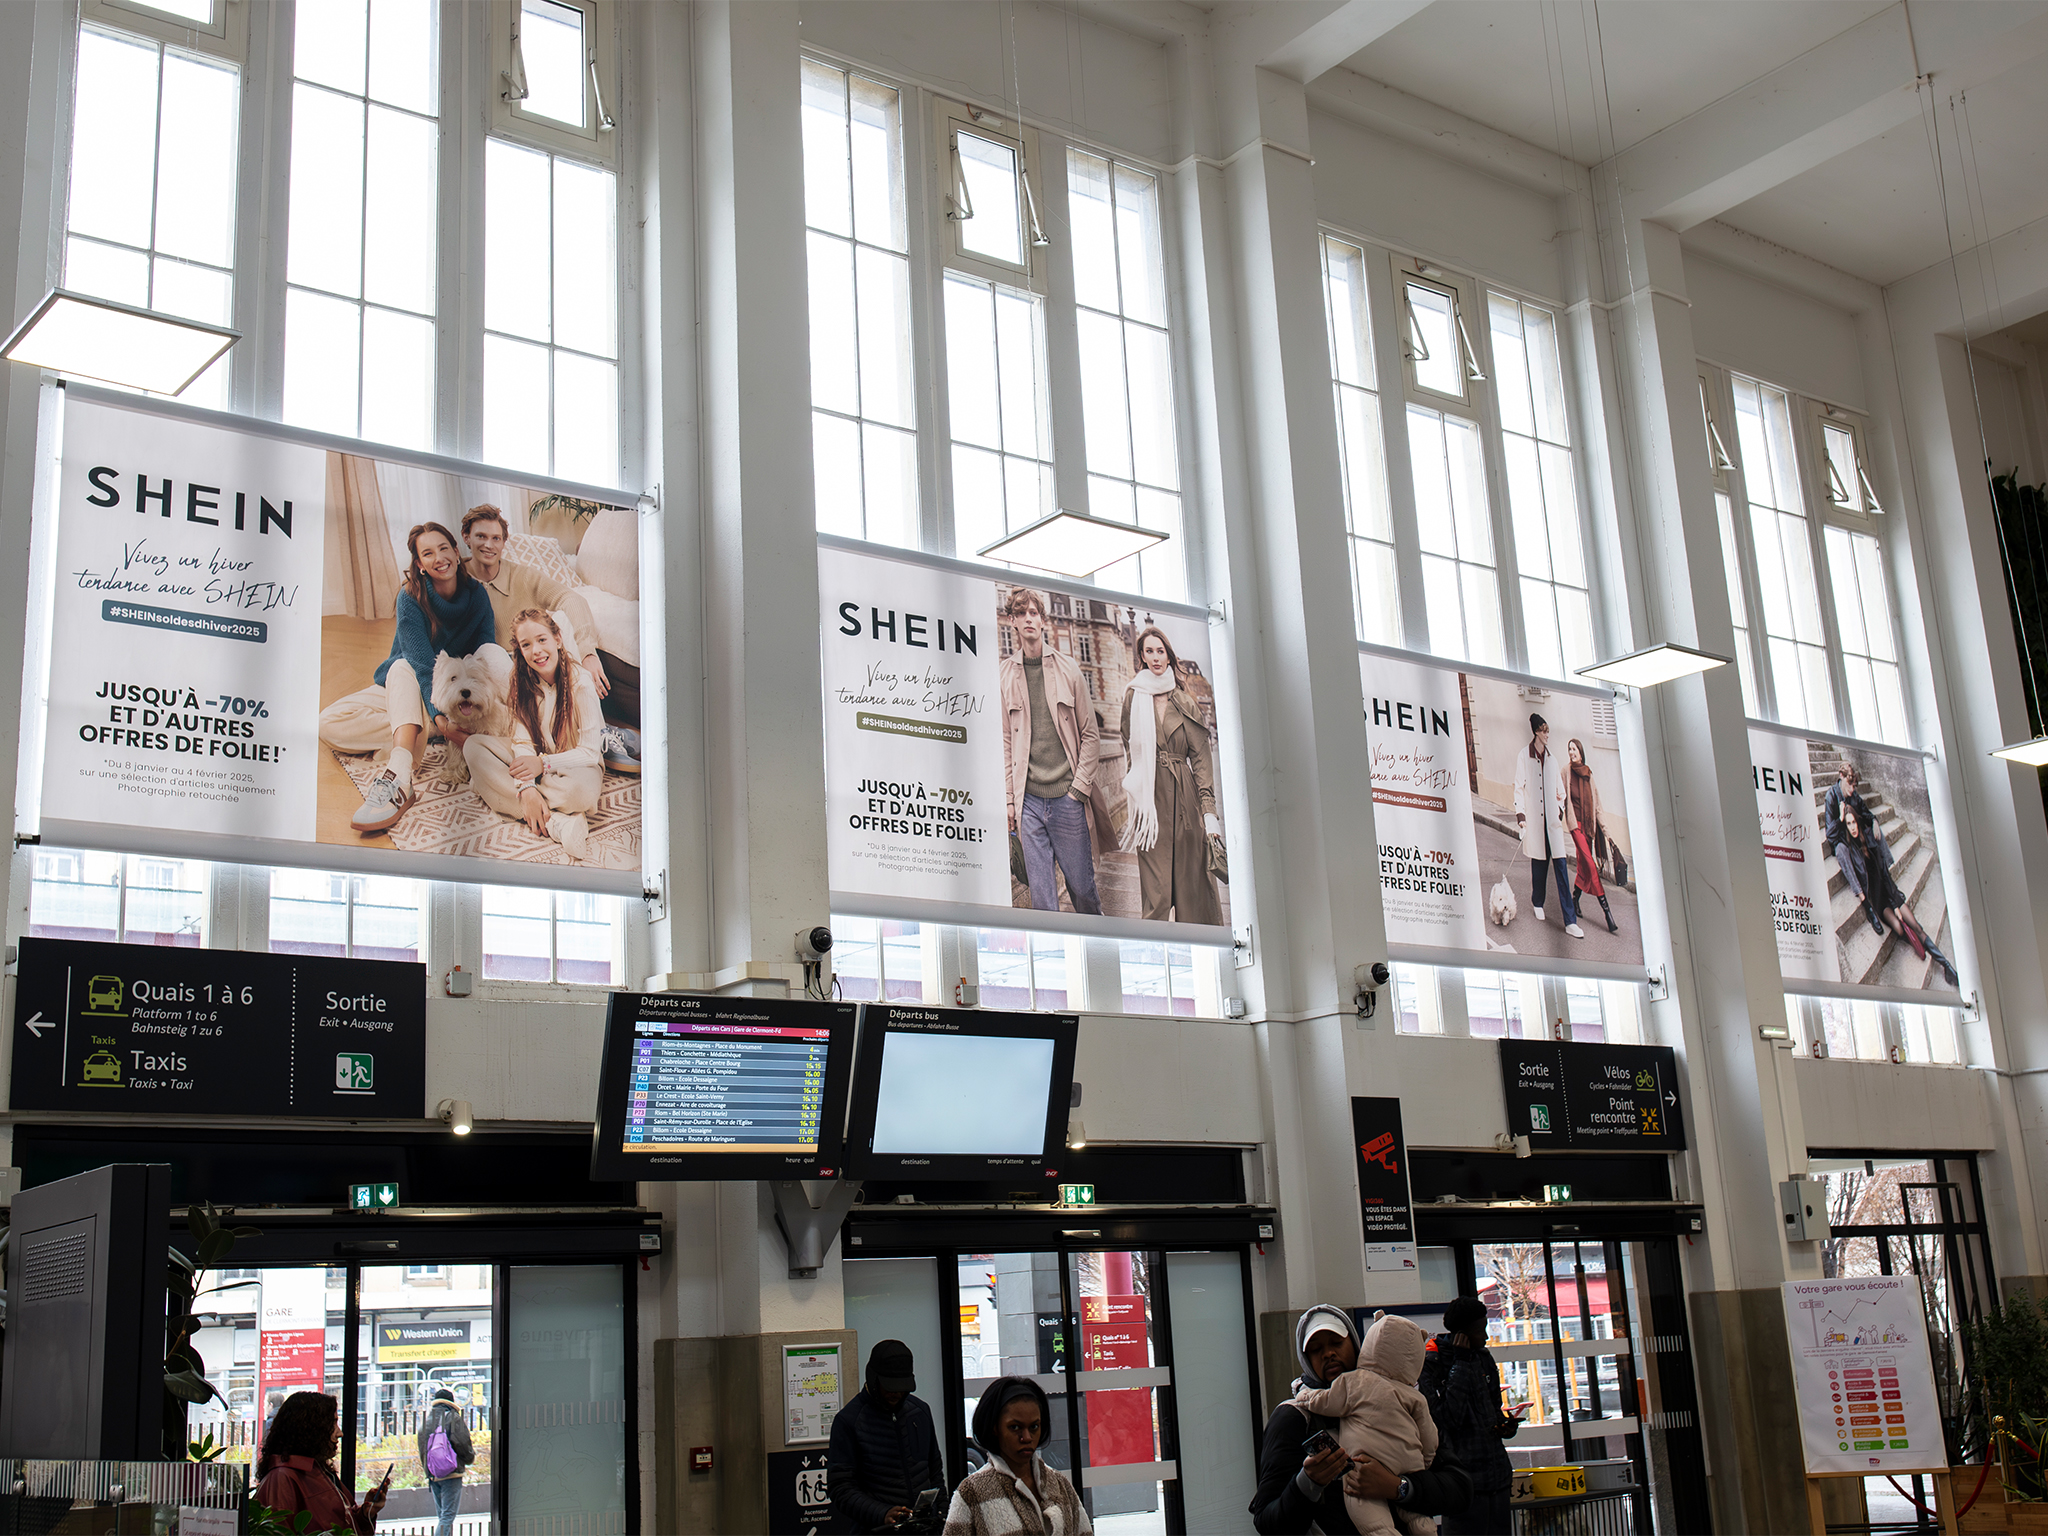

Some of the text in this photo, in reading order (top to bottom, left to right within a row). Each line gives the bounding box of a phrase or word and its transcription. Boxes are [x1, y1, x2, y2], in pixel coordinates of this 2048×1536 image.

[86, 466, 293, 540] SHEIN
[124, 538, 254, 576] Vivez un hiver
[72, 567, 299, 611] tendance avec SHEIN
[109, 605, 261, 637] #SHEINsoldesdhiver2025
[838, 602, 978, 657] SHEIN
[867, 660, 954, 692] Vivez un hiver
[96, 681, 200, 710] JUSQU'À
[835, 685, 985, 717] tendance avec SHEIN
[110, 705, 255, 739] ET D'AUTRES
[1362, 697, 1451, 738] HEIN
[861, 716, 963, 739] #SHEINsoldesdhiver2025
[79, 724, 169, 751] OFFRES
[174, 735, 204, 755] DE
[1372, 742, 1435, 769] Vivez un hiver
[124, 761, 132, 770] 8
[132, 761, 169, 774] janvier
[171, 767, 184, 776] au
[186, 767, 194, 777] 4
[195, 768, 228, 780] février
[229, 772, 255, 784] 2025,
[1391, 768, 1458, 791] avec SHEIN
[79, 768, 276, 796] sur une sélection d'articles uniquement
[857, 778, 927, 801] JUSQU'À
[117, 783, 240, 803] Photographie retouchée
[868, 798, 965, 823] ET D'AUTRES
[849, 814, 910, 835] OFFRES
[912, 821, 933, 838] DE
[1777, 824, 1811, 843] SHEIN
[887, 844, 911, 853] janvier
[928, 848, 950, 857] février
[851, 850, 983, 870] sur une sélection d'articles uniquement
[877, 861, 960, 877] Photographie retouchée
[1381, 860, 1450, 880] ET D'AUTRES
[1413, 879, 1428, 893] DE
[1782, 921, 1794, 933] DE
[131, 979, 254, 1006] Quais 1 à 6
[325, 991, 387, 1013] Sortie
[640, 996, 701, 1009] Départs cars
[132, 1007, 218, 1022] Platform 1 to 6
[889, 1009, 939, 1021] Départs bus
[131, 1022, 224, 1038] Bahnsteig 1 zu 6
[319, 1016, 395, 1033] Exit Ausgang
[720, 1025, 731, 1033] Cars
[815, 1029, 830, 1037] 14:06
[91, 1035, 117, 1046] Taxis
[130, 1049, 188, 1072] Taxis
[1519, 1062, 1550, 1077] Sortie
[1603, 1065, 1631, 1080] Vélos
[128, 1077, 194, 1091] Taxis Taxi
[1518, 1079, 1555, 1091] Exit Ausgang
[1589, 1081, 1632, 1091] Cycles Fahrräder
[1609, 1096, 1635, 1111] Point
[1590, 1111, 1637, 1125] rencontre
[1576, 1126, 1639, 1136] Meeting point Treffpunkt
[650, 1156, 683, 1164] destination
[803, 1157, 815, 1165] quai
[900, 1158, 931, 1166] destination
[1031, 1158, 1042, 1166] quai
[1380, 1205, 1393, 1213] ÊTES
[1392, 1205, 1408, 1213] DANS
[1374, 1214, 1394, 1222] ESPACE
[1366, 1223, 1384, 1231] VIDÉO
[1794, 1281, 1899, 1295] Votre gare vous écoute
[265, 1308, 293, 1317] GARE
[1039, 1318, 1059, 1328] Quais
[402, 1327, 464, 1339] Western Union
[390, 1349, 426, 1358] Transfert
[803, 1508, 829, 1516] Ascenseur
[810, 1515, 833, 1523] Ascensor
